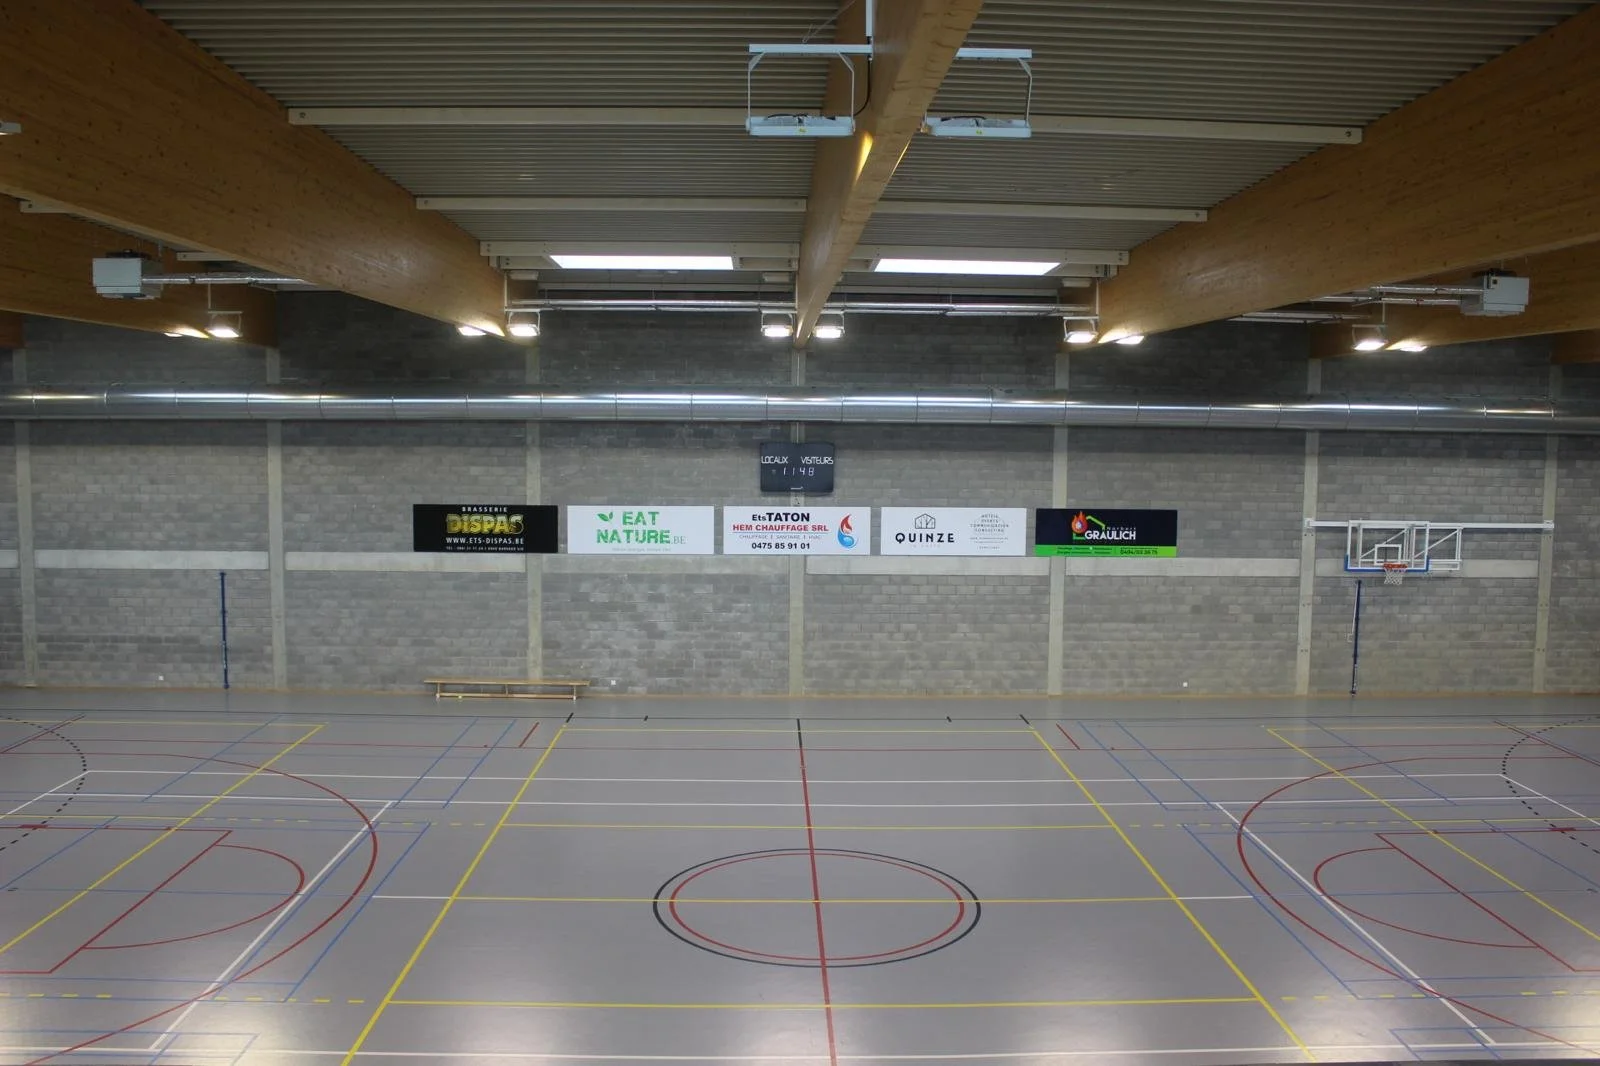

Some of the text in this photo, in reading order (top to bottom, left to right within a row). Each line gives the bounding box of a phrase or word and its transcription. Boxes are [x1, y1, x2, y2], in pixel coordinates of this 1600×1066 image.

[761, 456, 834, 464] LOCAUX VISITEURS
[622, 511, 659, 525] EAT
[896, 533, 954, 544] QUINZE
[1085, 530, 1136, 540] GRAULICH
